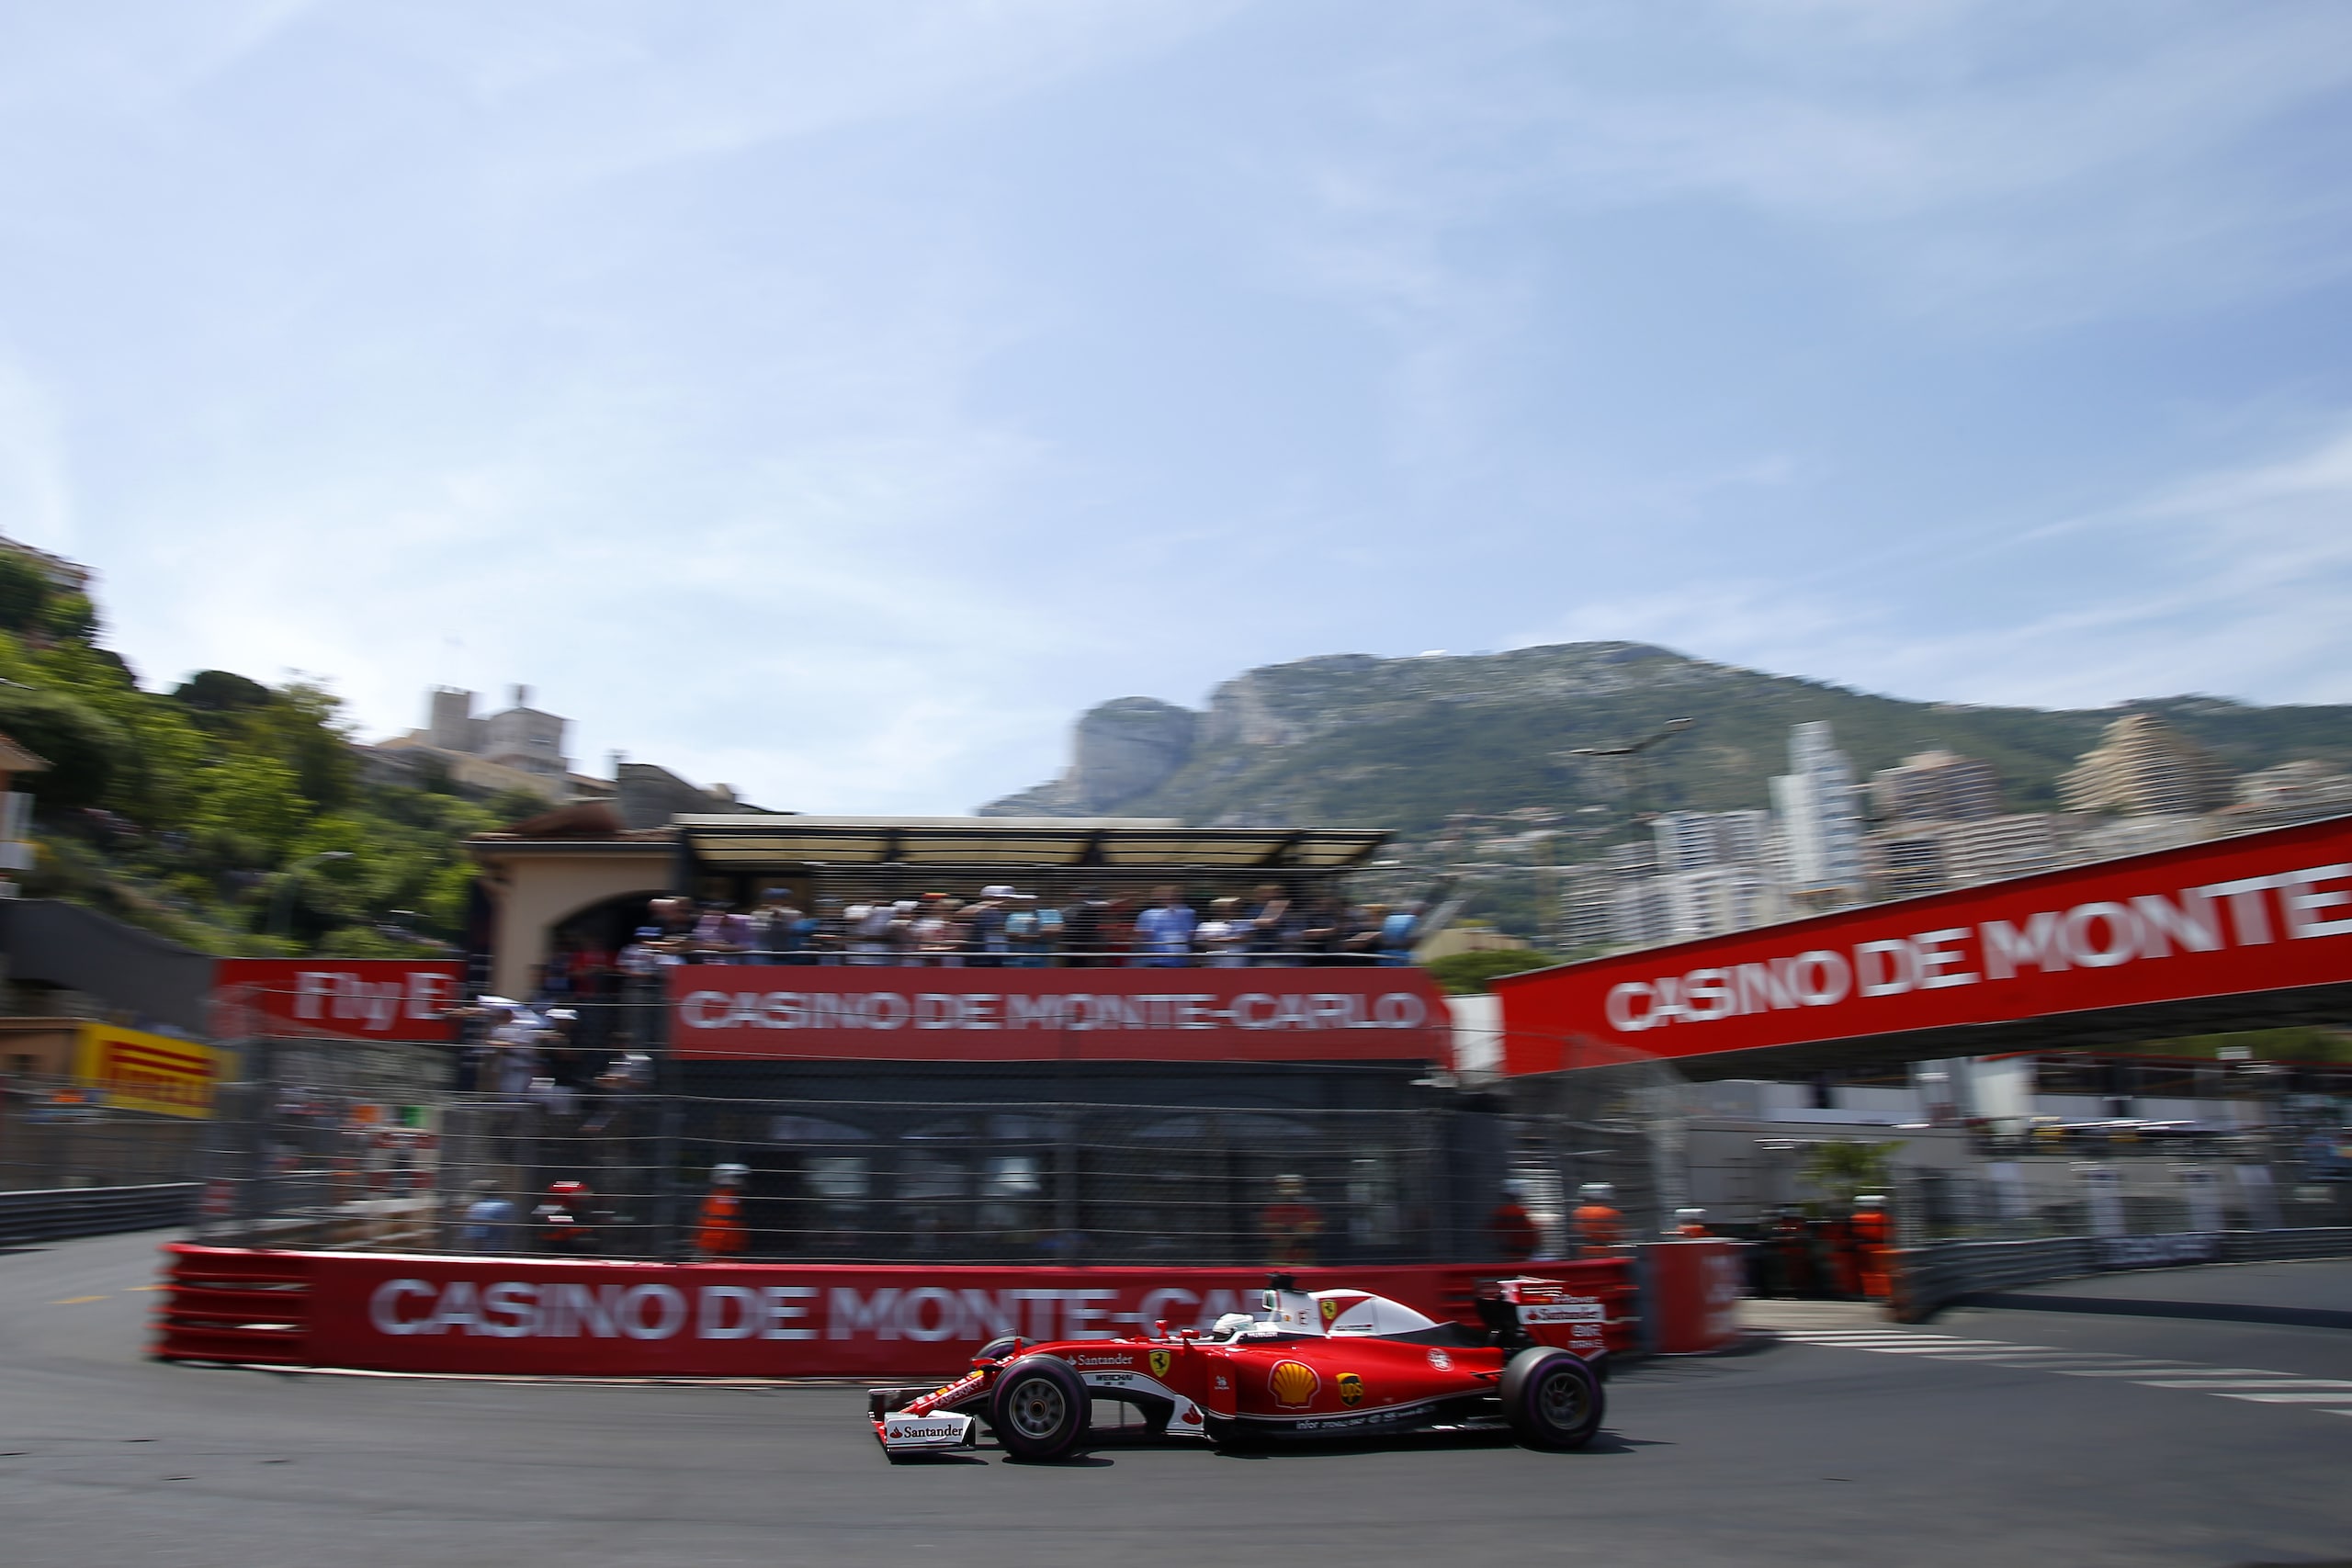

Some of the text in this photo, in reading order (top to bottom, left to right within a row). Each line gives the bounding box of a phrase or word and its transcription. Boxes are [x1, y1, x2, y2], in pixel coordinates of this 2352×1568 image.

[1606, 863, 2352, 1032] CASINO DE MONTE
[294, 972, 402, 1030] Fly
[680, 990, 1427, 1030] CASINO DE MONTE-CARLO
[370, 1279, 687, 1340] CASINO
[695, 1286, 820, 1340] DE
[1078, 1353, 1134, 1366] Santander
[904, 1425, 963, 1438] Santander
